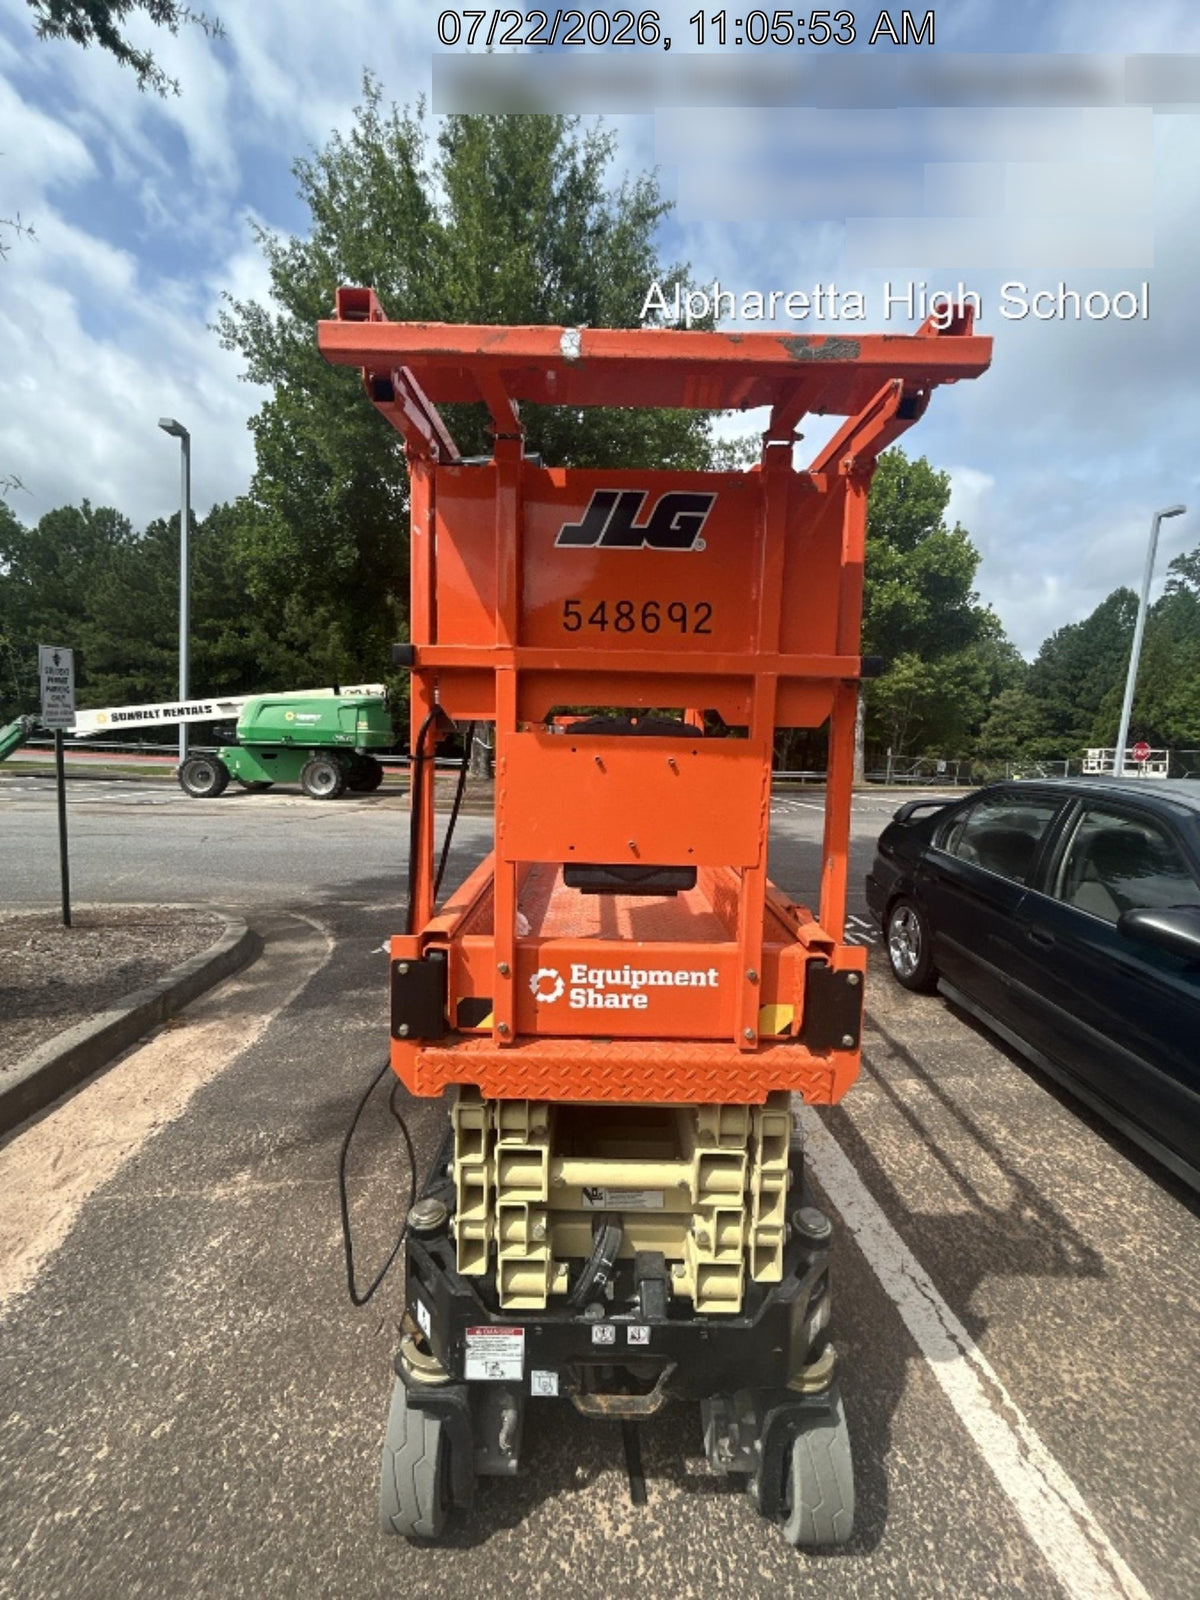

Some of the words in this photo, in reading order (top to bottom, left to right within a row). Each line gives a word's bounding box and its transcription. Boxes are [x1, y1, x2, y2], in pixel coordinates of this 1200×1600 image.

[563, 600, 713, 633] 548692
[111, 709, 161, 723] SUNBELT
[162, 705, 213, 718] RENTALS
[570, 964, 719, 989] Equipment
[569, 988, 648, 1009] Share
